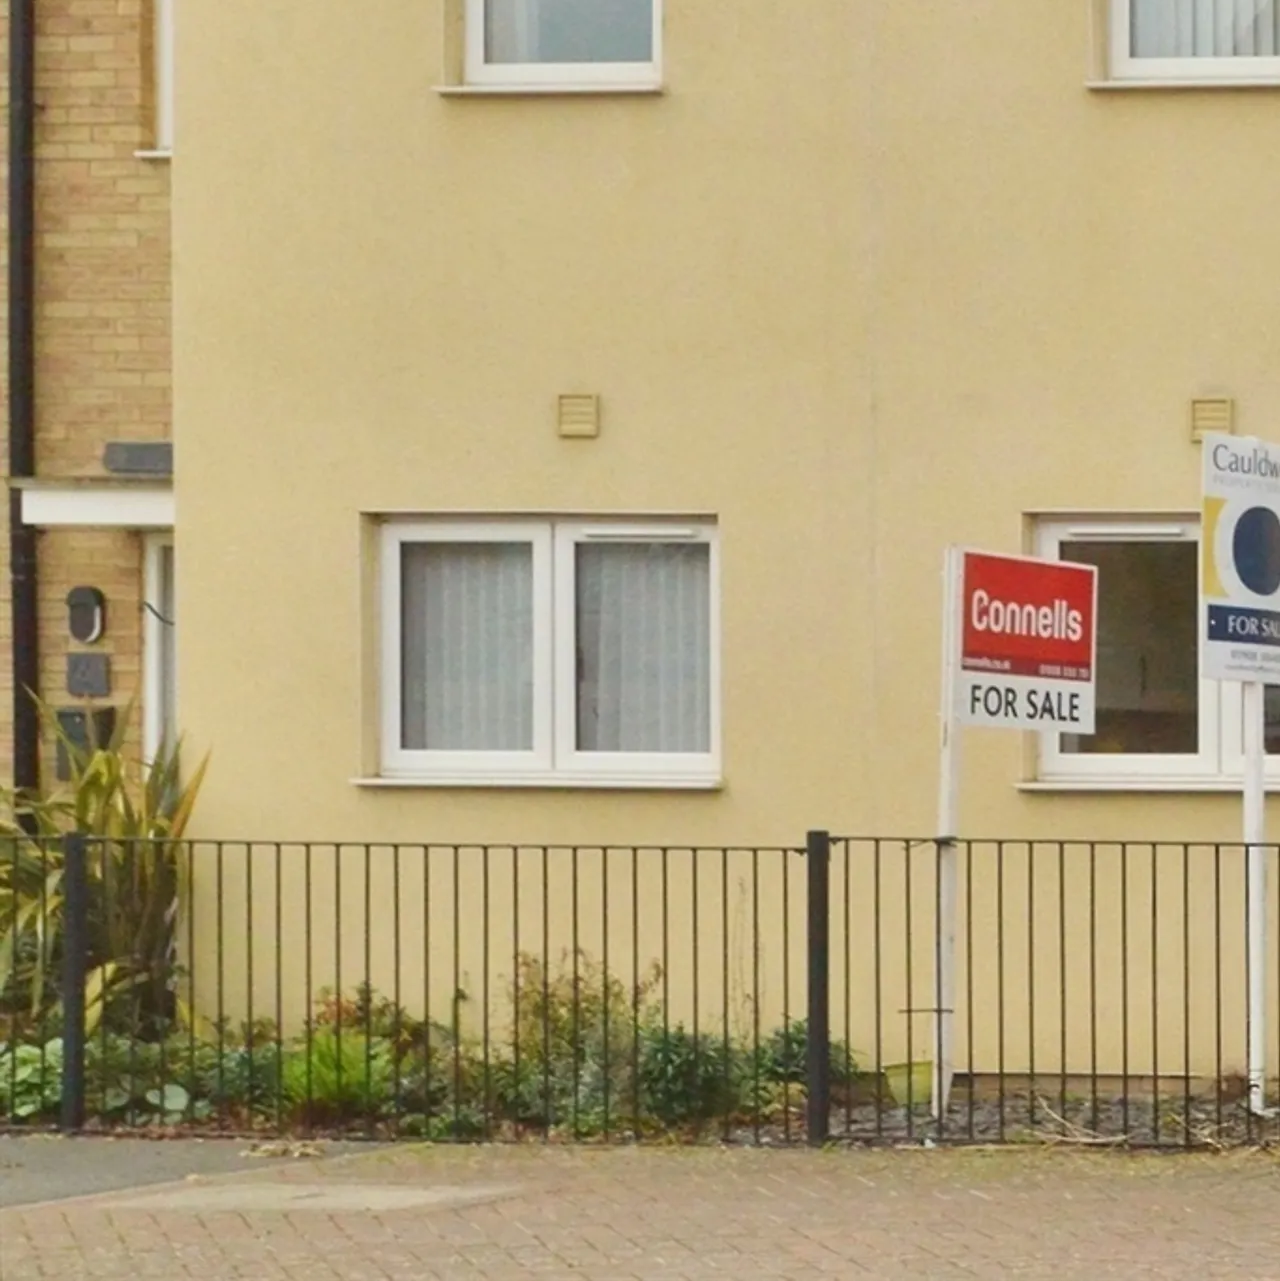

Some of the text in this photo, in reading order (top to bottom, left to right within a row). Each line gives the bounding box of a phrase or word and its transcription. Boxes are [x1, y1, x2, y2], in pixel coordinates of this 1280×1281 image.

[971, 589, 1083, 643] Connells
[1227, 614, 1259, 636] FOR
[970, 684, 1081, 723] FOR SALE
